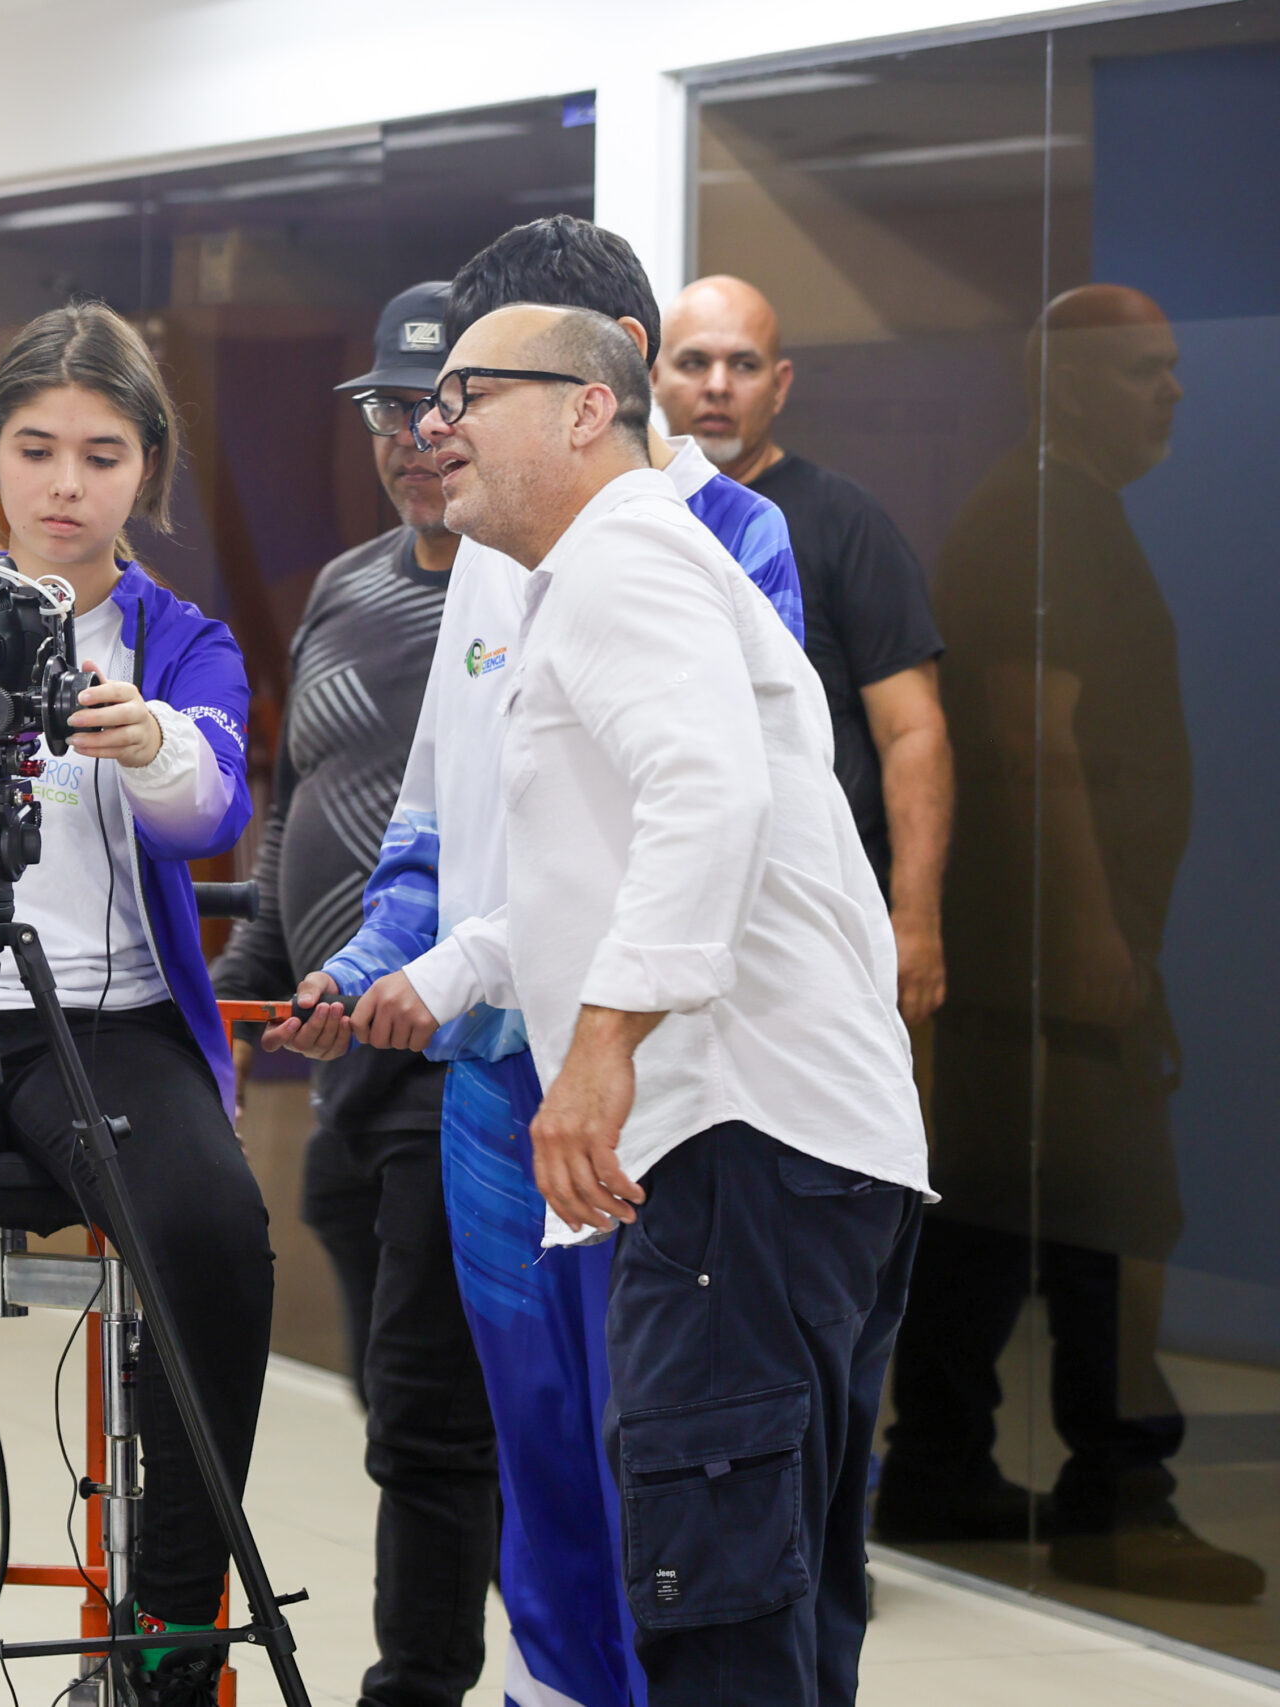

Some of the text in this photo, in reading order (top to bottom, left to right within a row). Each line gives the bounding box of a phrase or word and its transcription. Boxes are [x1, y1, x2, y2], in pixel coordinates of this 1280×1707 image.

[180, 705, 237, 730] CIENCIA Y
[656, 1569, 676, 1578] Jeep
